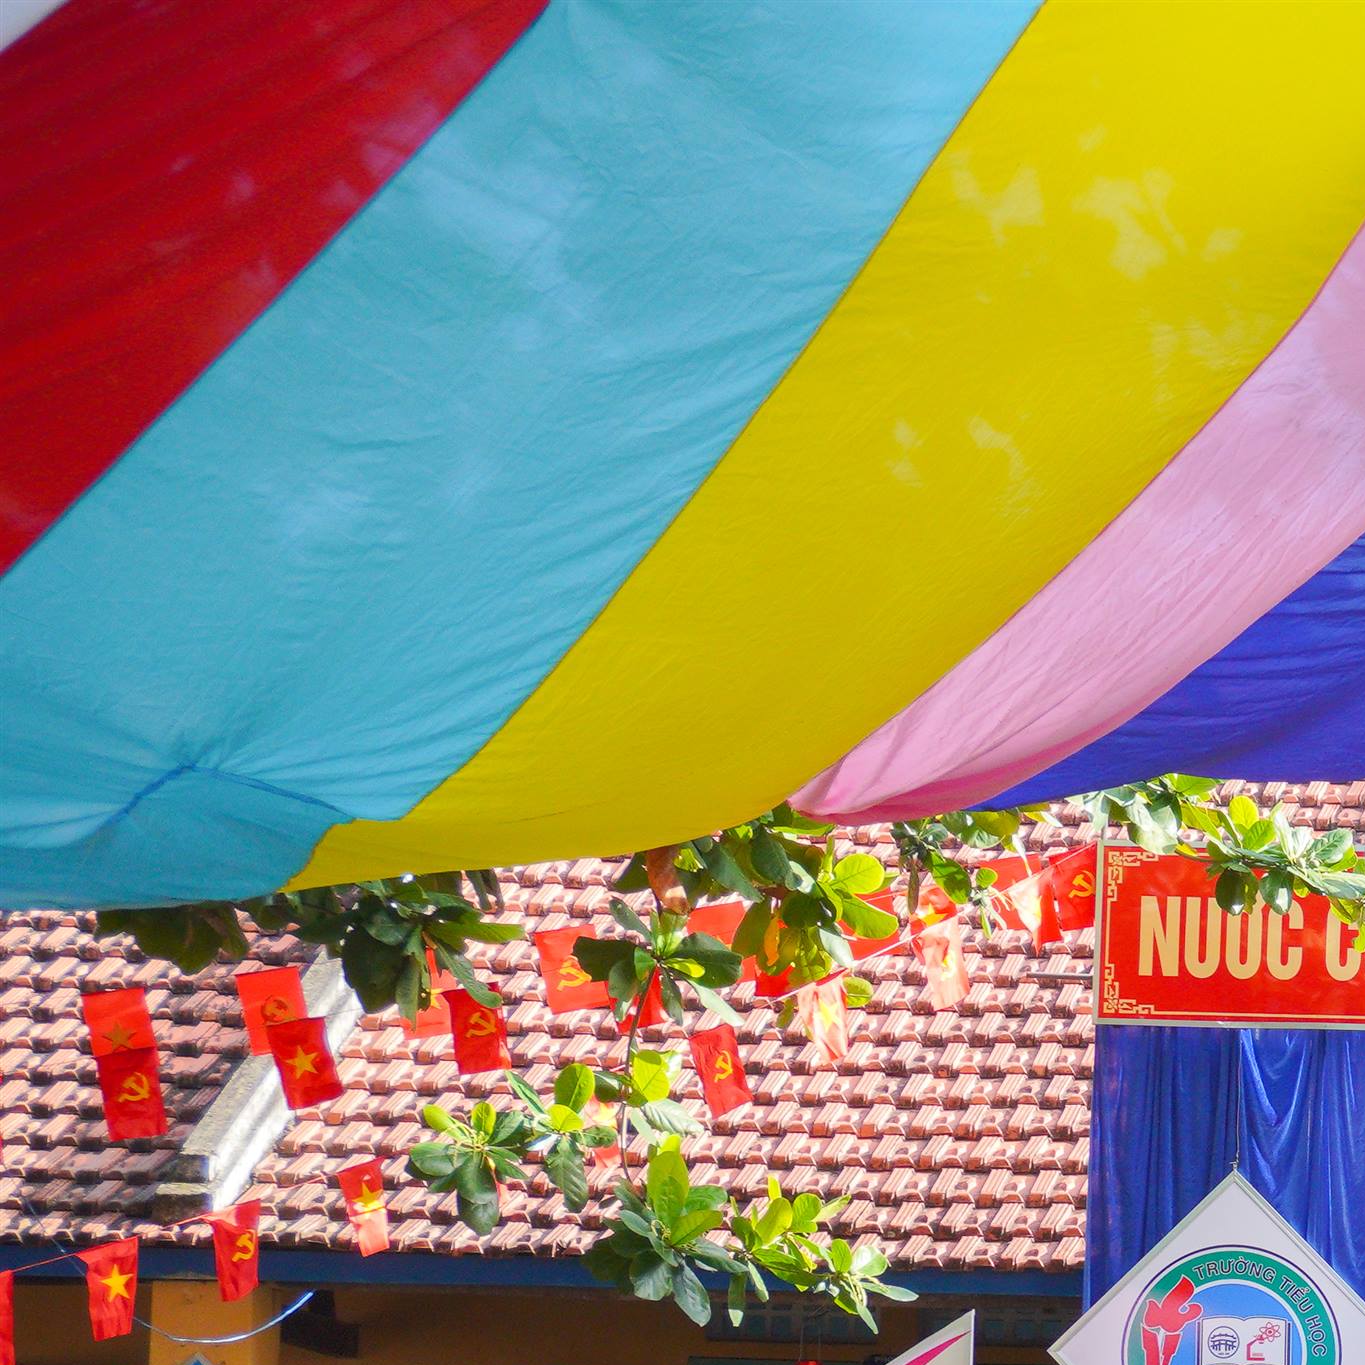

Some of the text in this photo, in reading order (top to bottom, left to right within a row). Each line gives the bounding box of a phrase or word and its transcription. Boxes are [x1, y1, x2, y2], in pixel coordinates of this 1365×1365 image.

[1193, 1256, 1327, 1356] TRƯỜNG TIỂU HỌC
